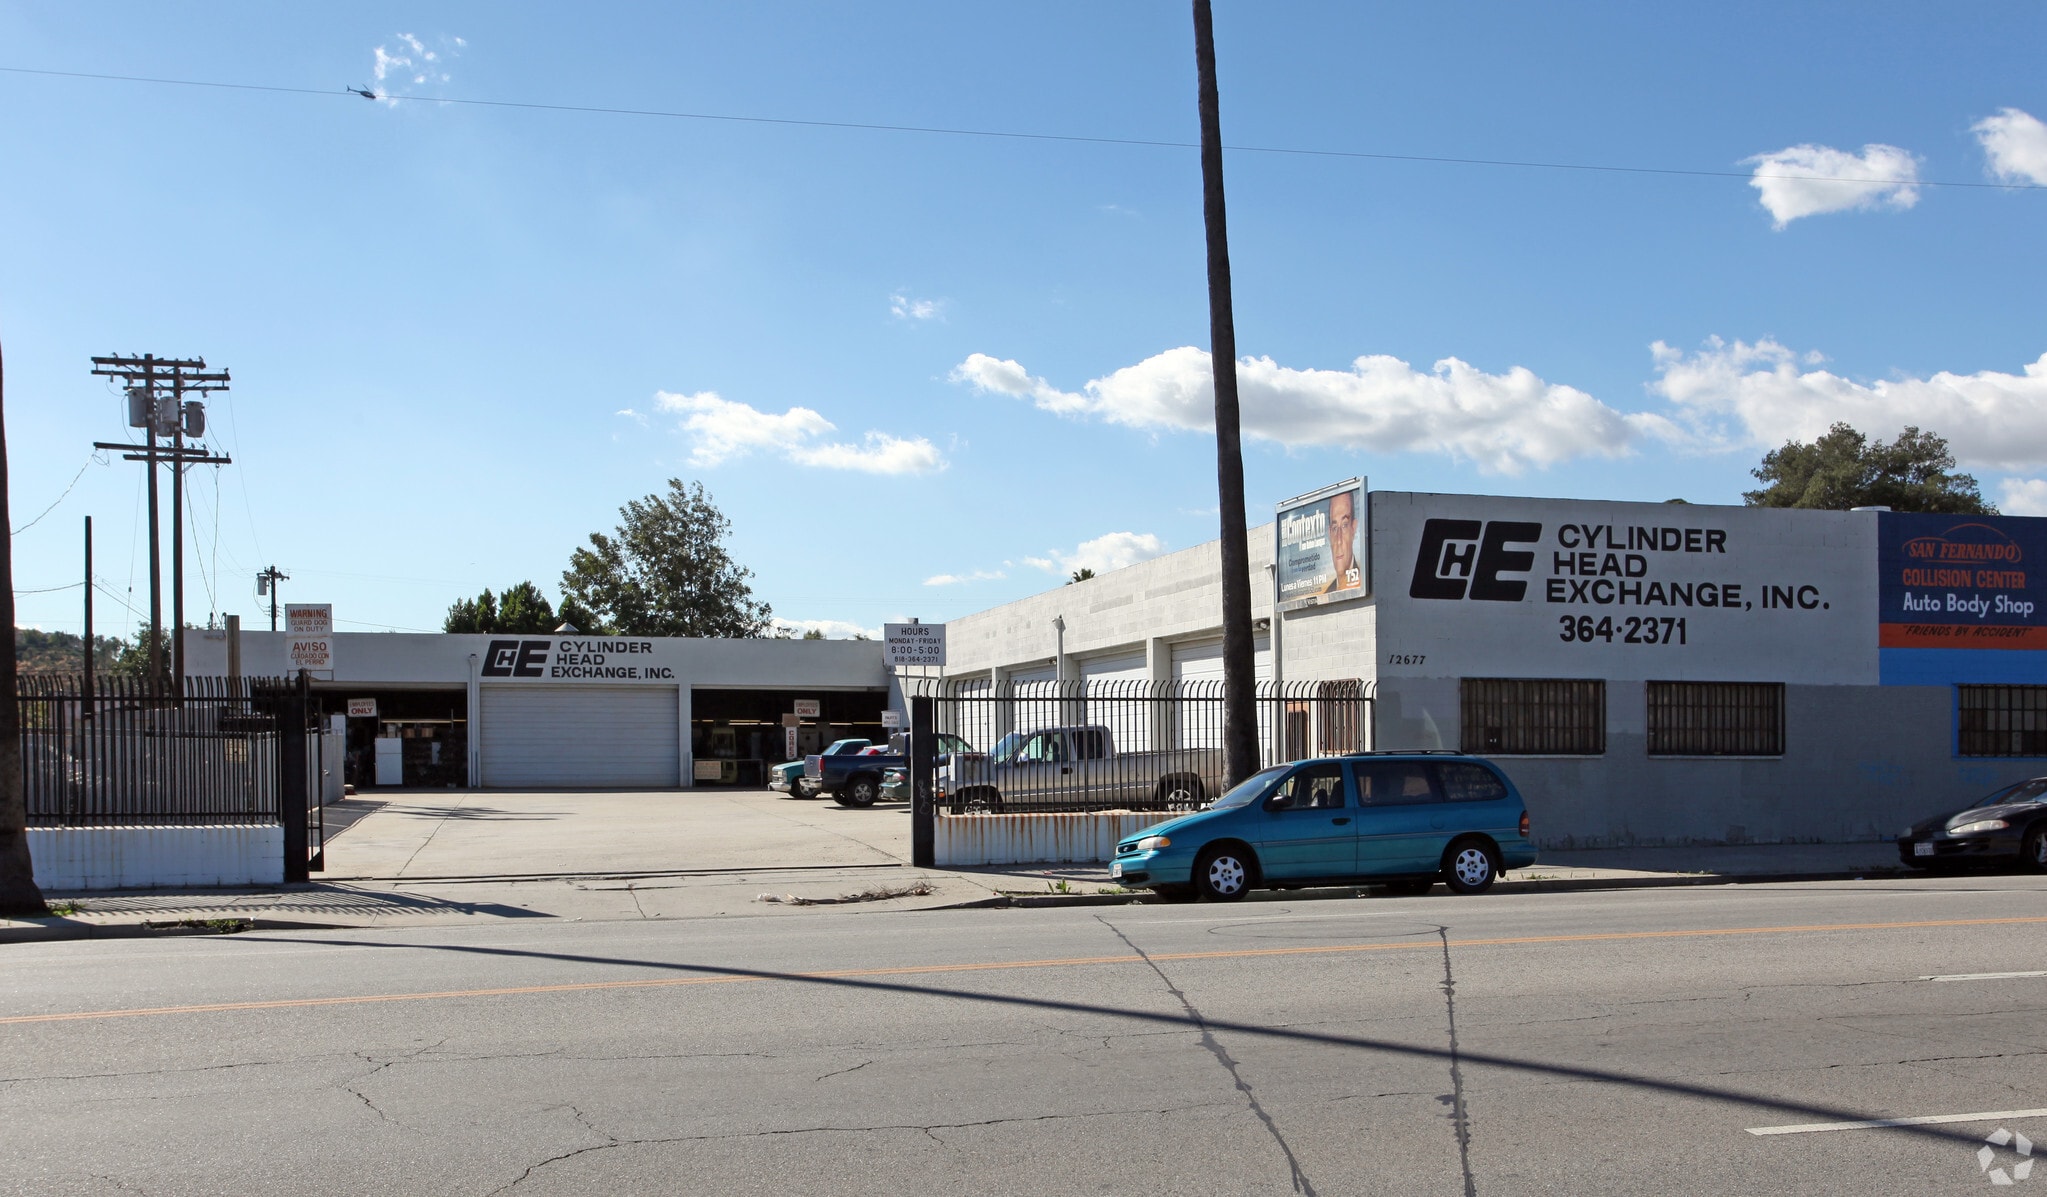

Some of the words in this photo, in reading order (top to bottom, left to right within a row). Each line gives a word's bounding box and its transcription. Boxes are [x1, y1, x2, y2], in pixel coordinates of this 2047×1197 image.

[1557, 524, 1727, 553] CYLINDER
[1909, 542, 1936, 558] SAN
[1939, 542, 2016, 560] FERNANDO
[1553, 552, 1648, 578] HEAD
[1903, 568, 1971, 587] COLLISION
[1976, 570, 2026, 589] CENTER
[1546, 578, 1753, 613] EXCHANGE,
[1761, 585, 1830, 610] INC.
[1903, 591, 1941, 612] Auto
[1946, 593, 1990, 619] Body
[1995, 595, 2035, 618] Shop
[290, 609, 327, 618] WARNING
[901, 627, 930, 636] HOURS
[293, 641, 327, 651] AVISO
[559, 640, 652, 654] CYLINDER
[556, 653, 605, 665] HEAD
[1389, 654, 1426, 665] 12677
[551, 666, 642, 680] EXCHANGE,
[644, 667, 675, 679] INC.
[351, 707, 373, 715] ONLY
[797, 707, 817, 715] ONLY
